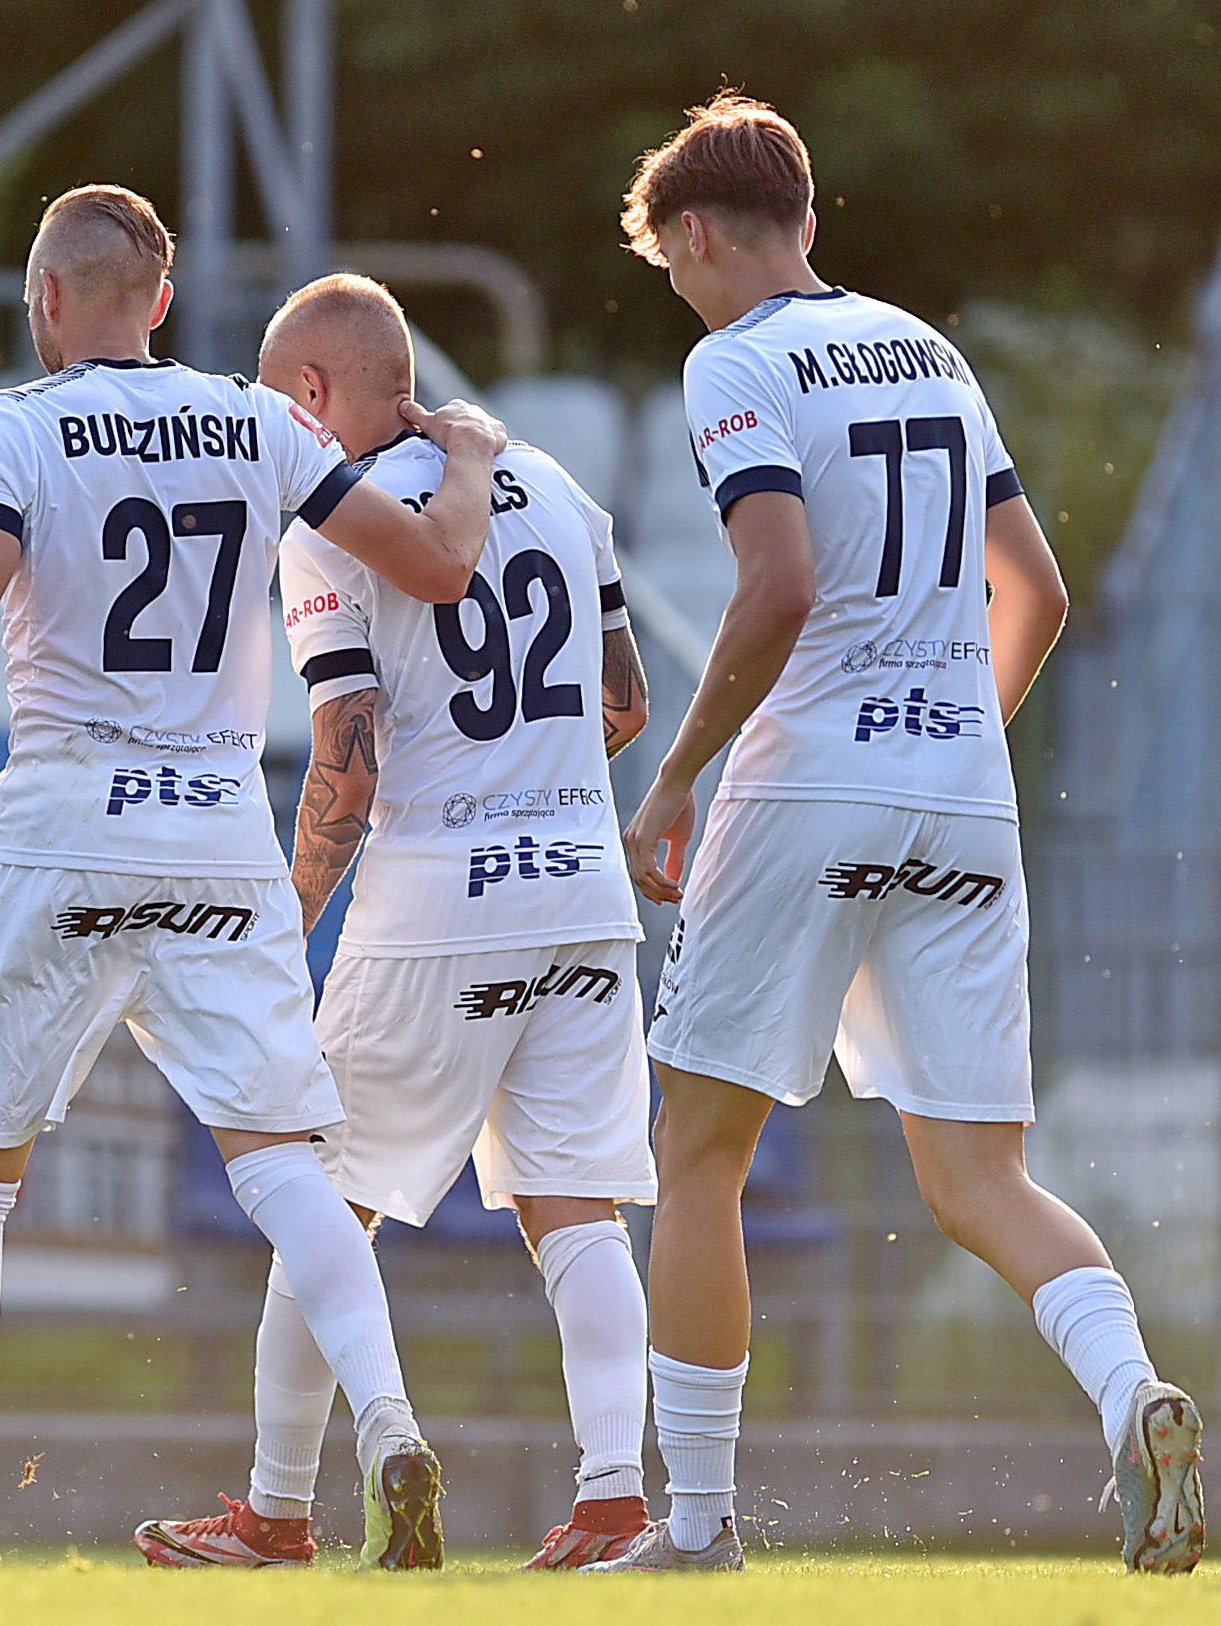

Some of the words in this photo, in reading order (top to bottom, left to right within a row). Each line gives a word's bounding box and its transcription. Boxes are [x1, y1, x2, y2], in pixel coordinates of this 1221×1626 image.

[59, 405, 259, 463] BUDZIŃSKI
[848, 416, 967, 597] 77
[102, 496, 247, 672] 27
[433, 549, 584, 742] 92
[883, 639, 949, 658] CZYSTY
[951, 642, 990, 666] EFKT
[206, 729, 258, 750] EFEKT
[854, 688, 984, 742] pts
[106, 766, 240, 816] pts
[482, 790, 552, 811] CZYSTY
[468, 836, 604, 898] pts
[51, 901, 253, 942] RISUM
